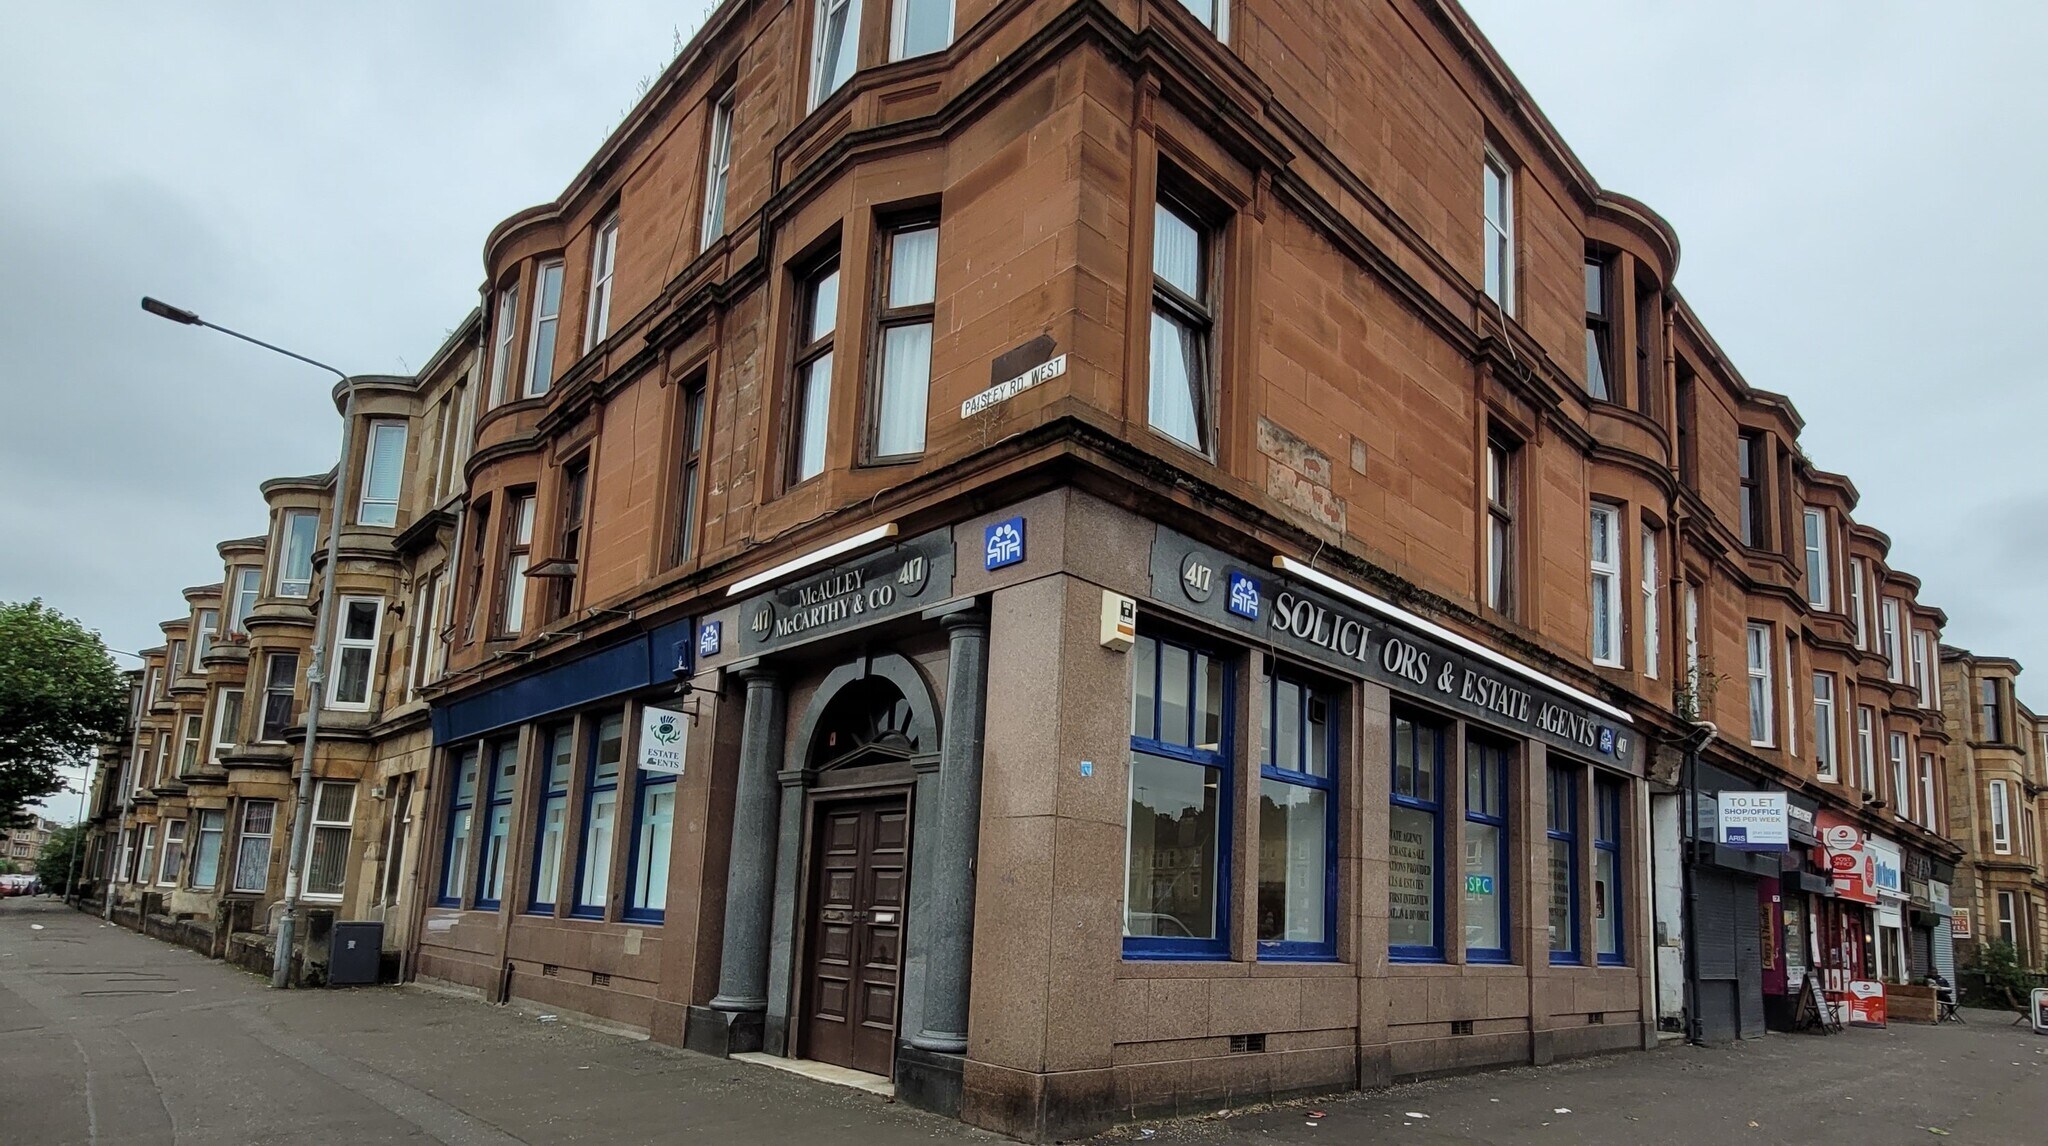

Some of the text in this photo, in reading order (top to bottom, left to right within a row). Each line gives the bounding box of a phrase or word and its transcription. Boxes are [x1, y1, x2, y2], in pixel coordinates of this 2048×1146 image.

[964, 358, 1061, 416] PAISLEY RD. WEST
[898, 556, 923, 585] 417
[1184, 562, 1212, 592] 417
[799, 568, 864, 608] McAULEY
[751, 608, 770, 632] 417
[775, 585, 893, 638] McCARTHY & CO
[1437, 661, 1455, 694] &
[1460, 669, 1532, 722] ESTATE
[1536, 701, 1597, 748] AGENTS
[648, 748, 679, 760] ESTATE
[1724, 808, 1781, 816] SHOP/OFFICE
[1729, 798, 1775, 807] TO LET
[1465, 876, 1490, 893] SPC
